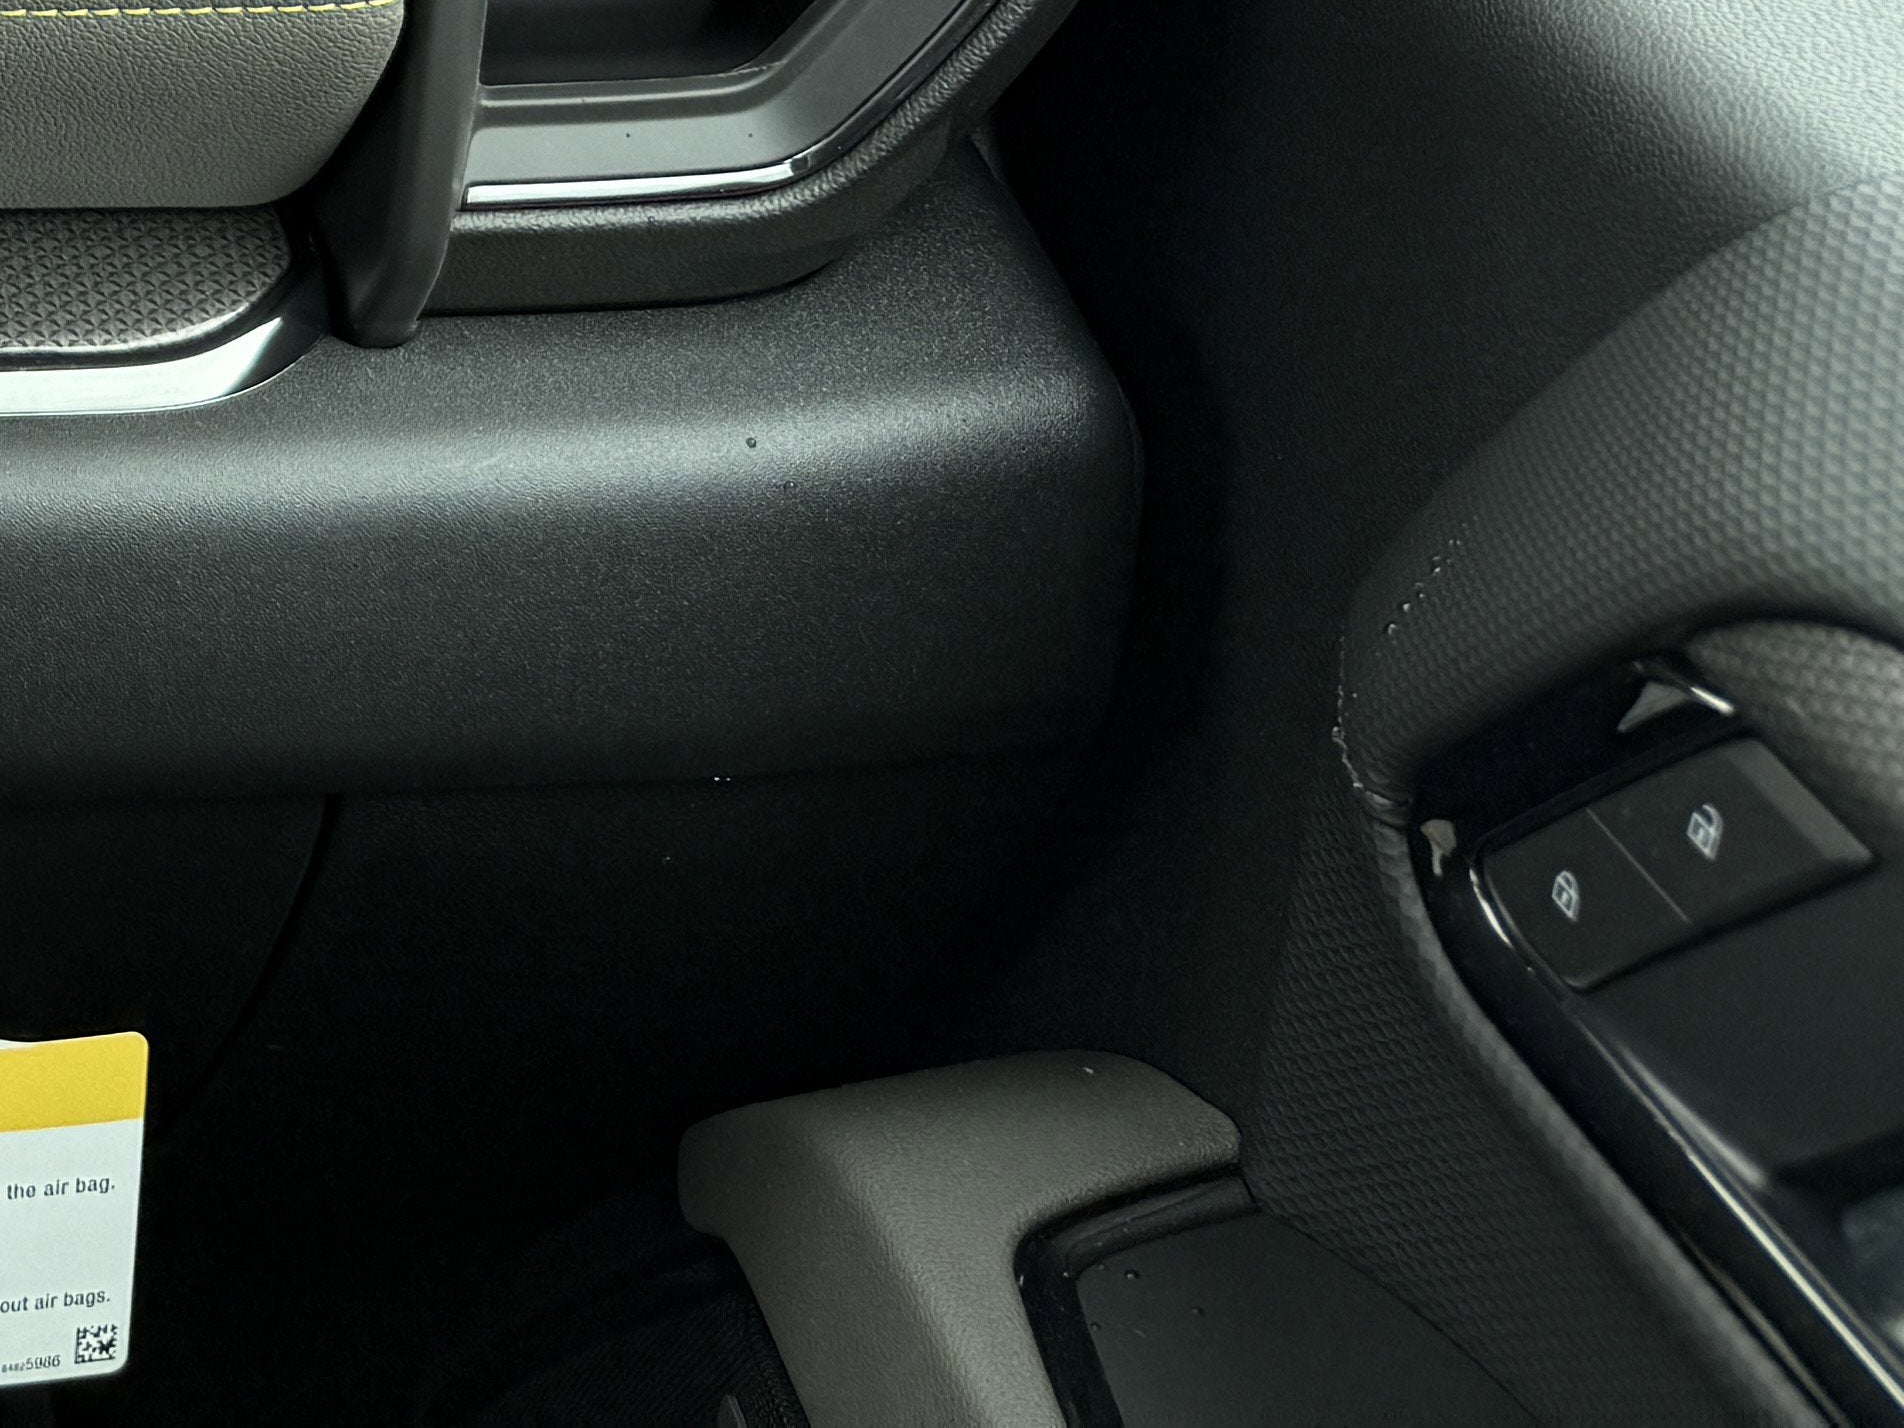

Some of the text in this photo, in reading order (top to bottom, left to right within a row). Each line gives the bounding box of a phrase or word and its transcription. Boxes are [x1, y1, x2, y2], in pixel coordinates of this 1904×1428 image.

[7, 1182, 37, 1200] the
[43, 1180, 70, 1197] air
[75, 1176, 116, 1195] bag.
[35, 1293, 58, 1311] air
[63, 1288, 112, 1309] bags.
